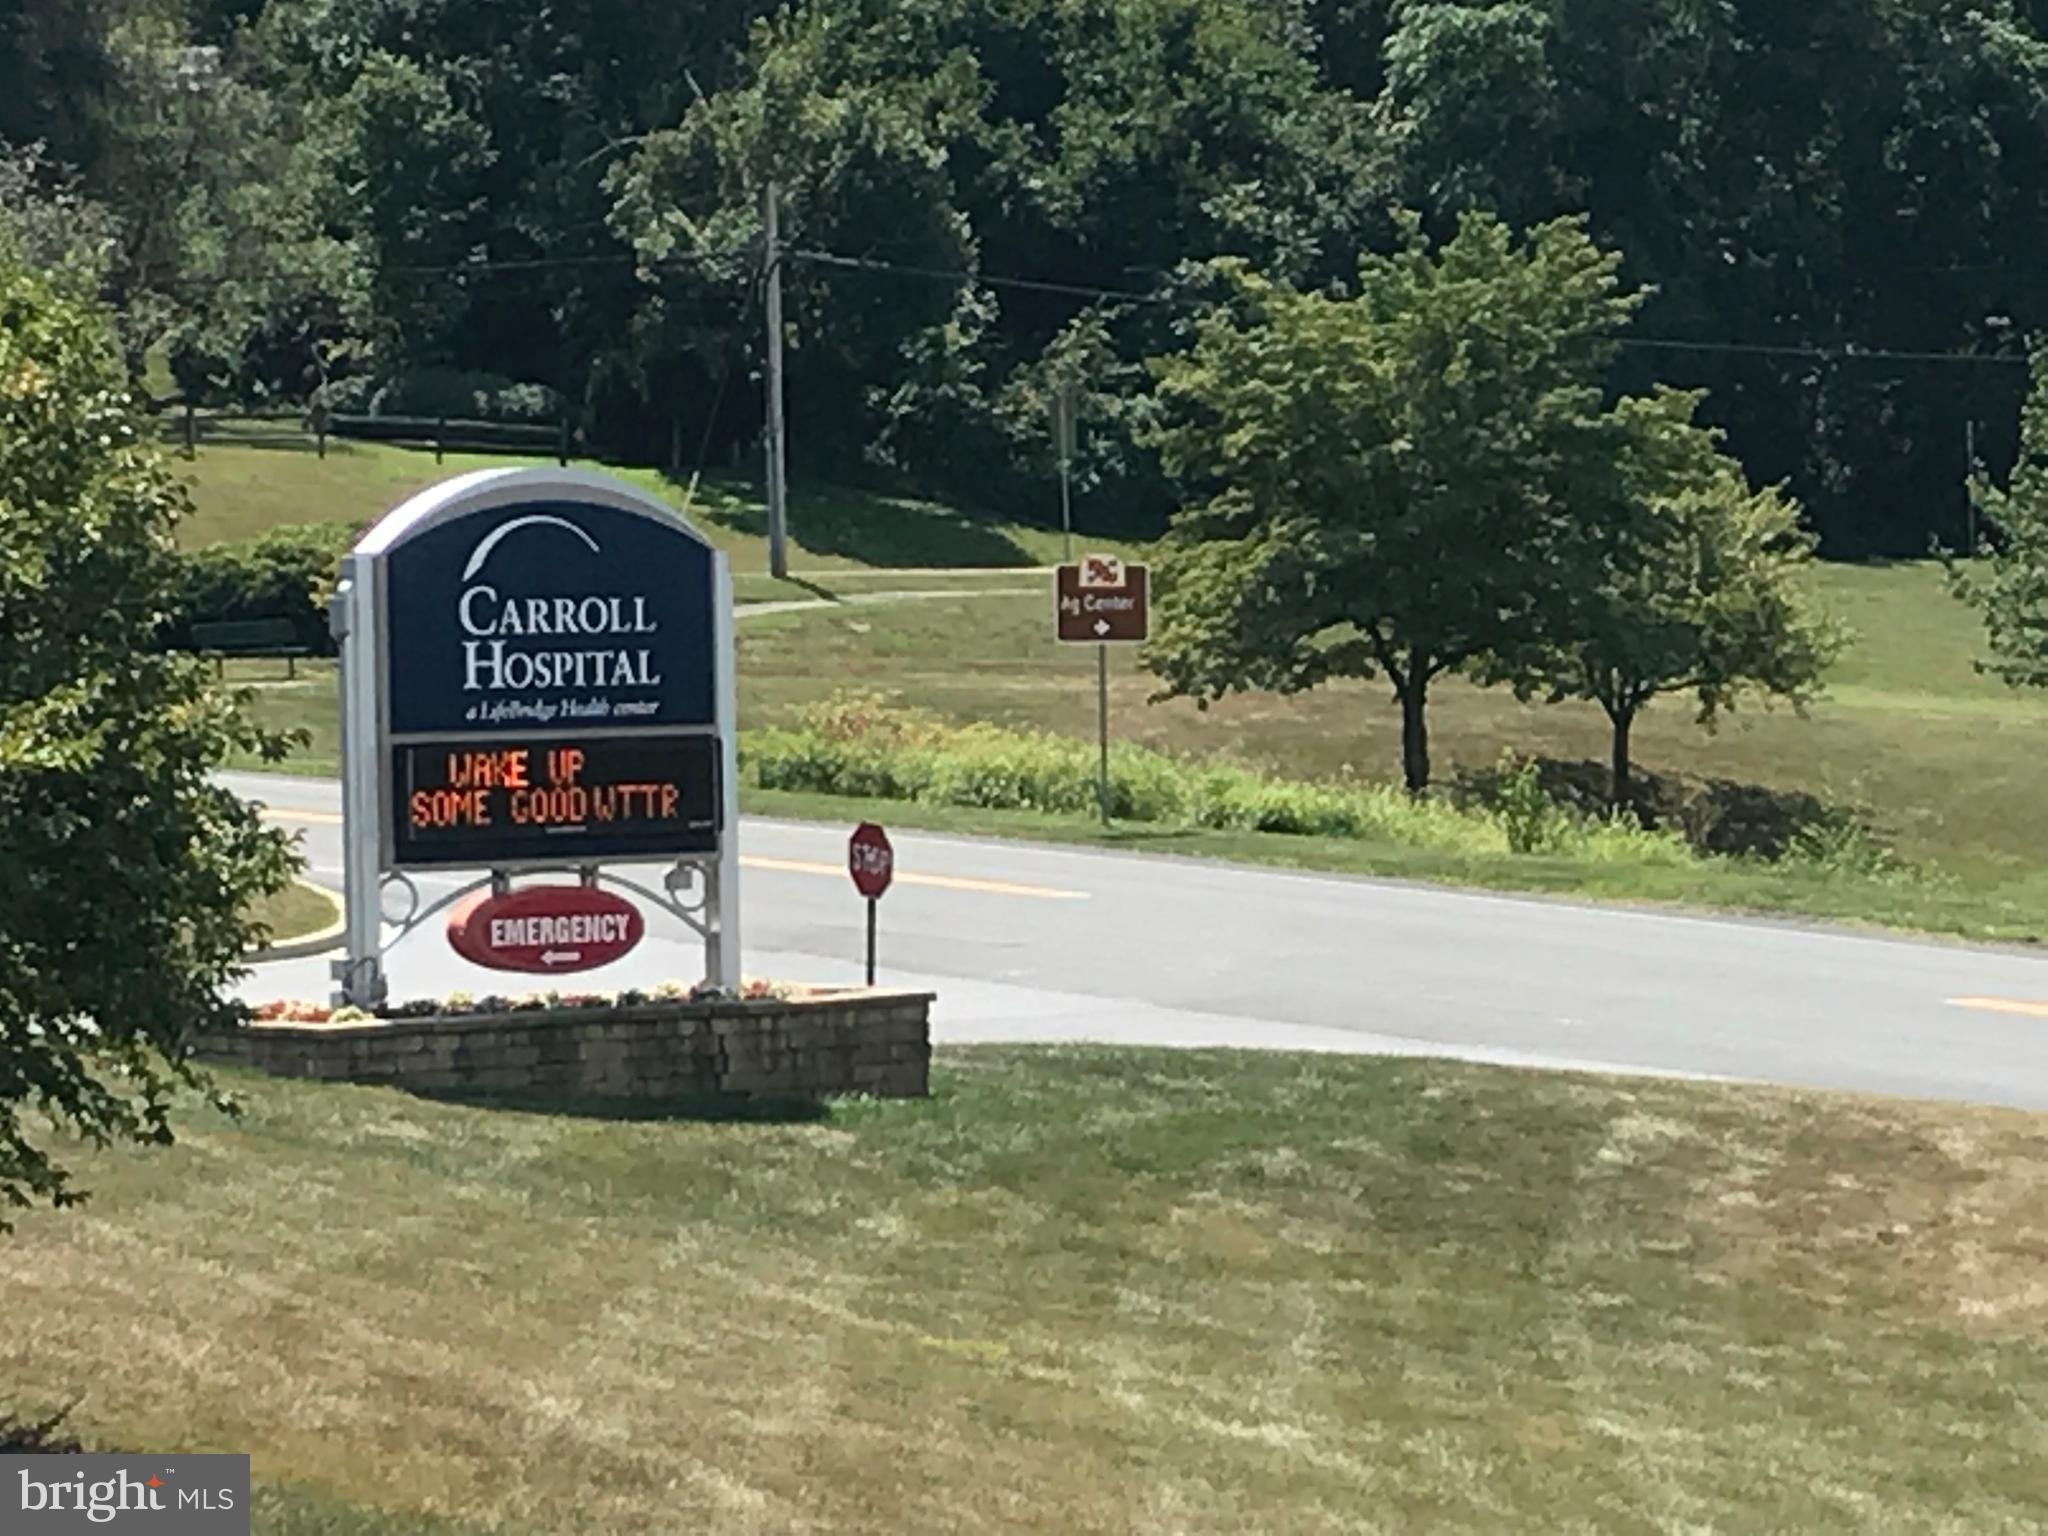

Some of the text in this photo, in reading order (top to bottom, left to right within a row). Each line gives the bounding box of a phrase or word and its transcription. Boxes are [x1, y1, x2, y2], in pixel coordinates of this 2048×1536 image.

[459, 585, 658, 635] CARROLL
[461, 640, 661, 689] HOSPITAL
[560, 697, 611, 717] Health
[448, 749, 585, 789] WAKE UP
[411, 790, 492, 828] SOME
[511, 787, 587, 825] GOOD
[490, 914, 631, 948] EMERGENCY
